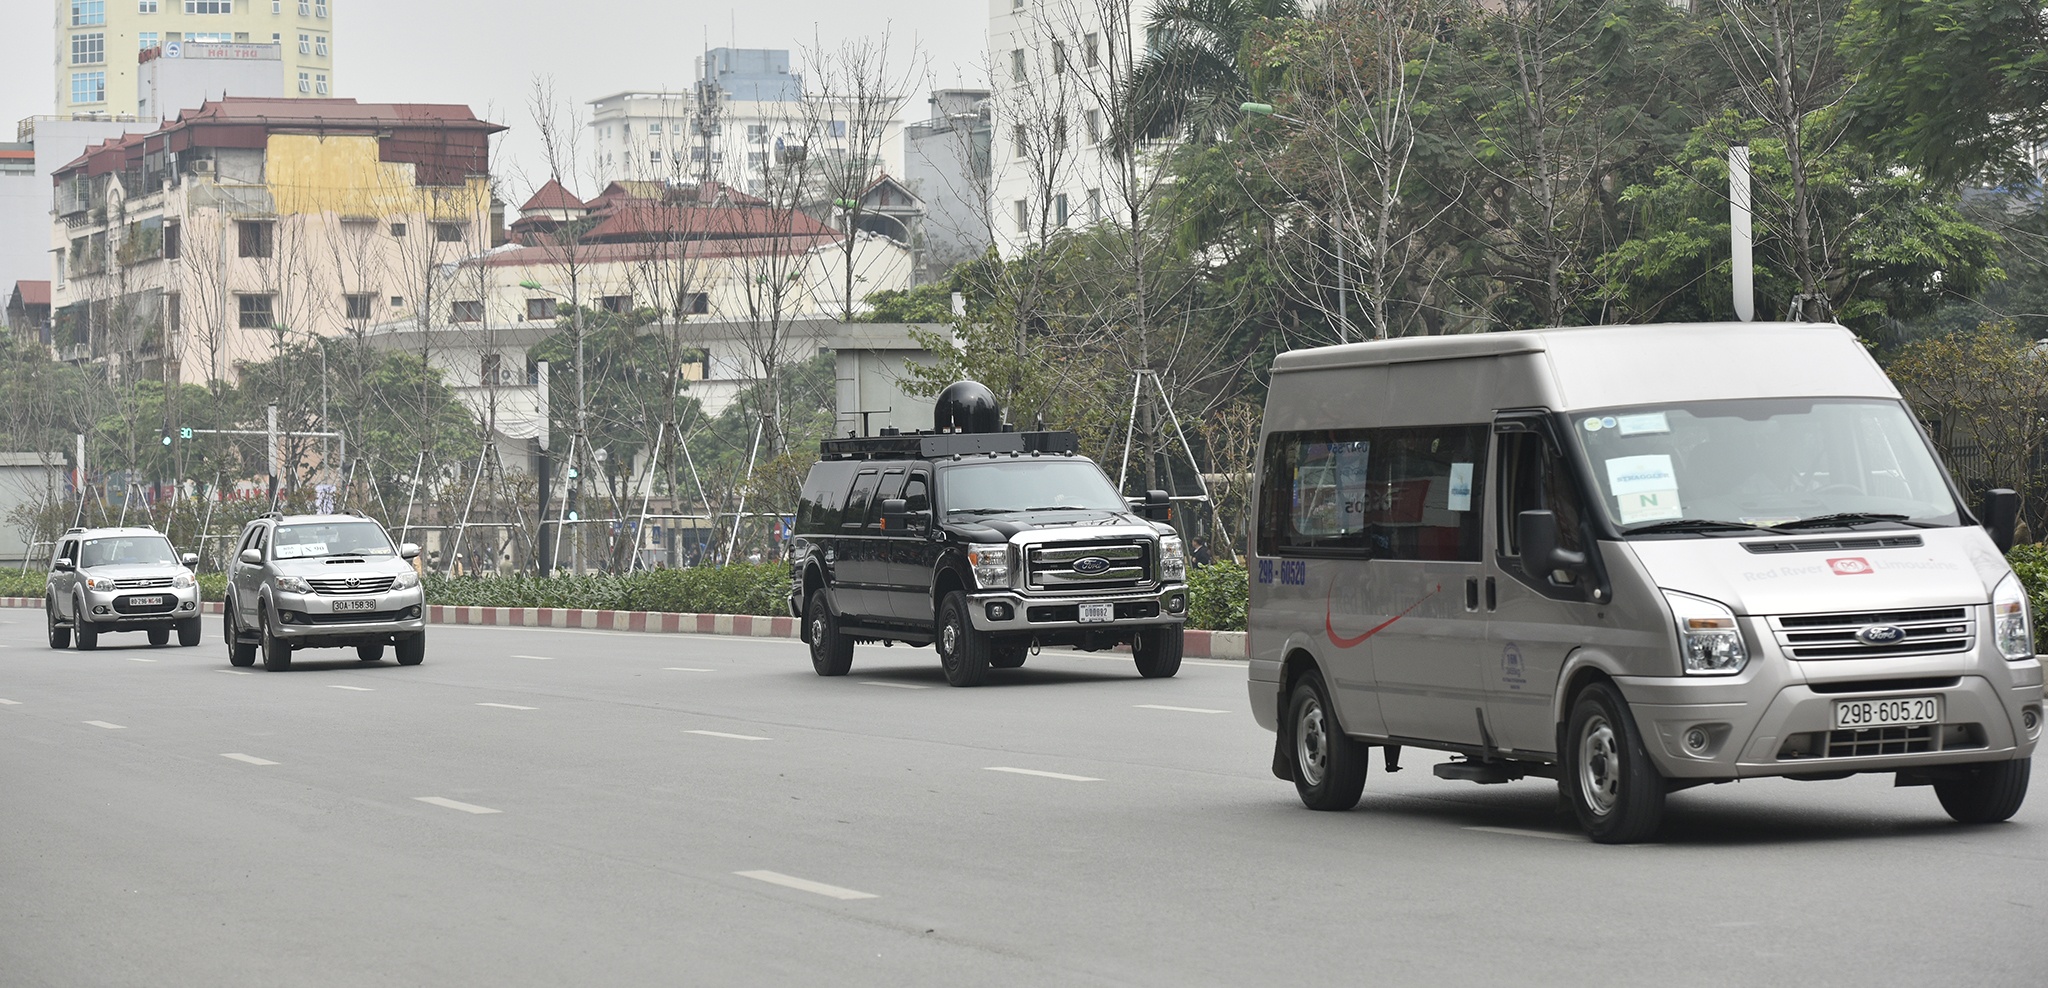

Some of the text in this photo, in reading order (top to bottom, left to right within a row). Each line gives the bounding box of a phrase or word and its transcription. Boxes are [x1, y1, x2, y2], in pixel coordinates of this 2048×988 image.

[181, 428, 192, 438] 30
[1640, 493, 1659, 507] N
[1081, 559, 1102, 570] Ford
[1743, 570, 1777, 582] Red
[1875, 559, 1959, 571] Limousine
[1869, 627, 1896, 640] Ford
[1840, 700, 1934, 724] 29B-605.20
